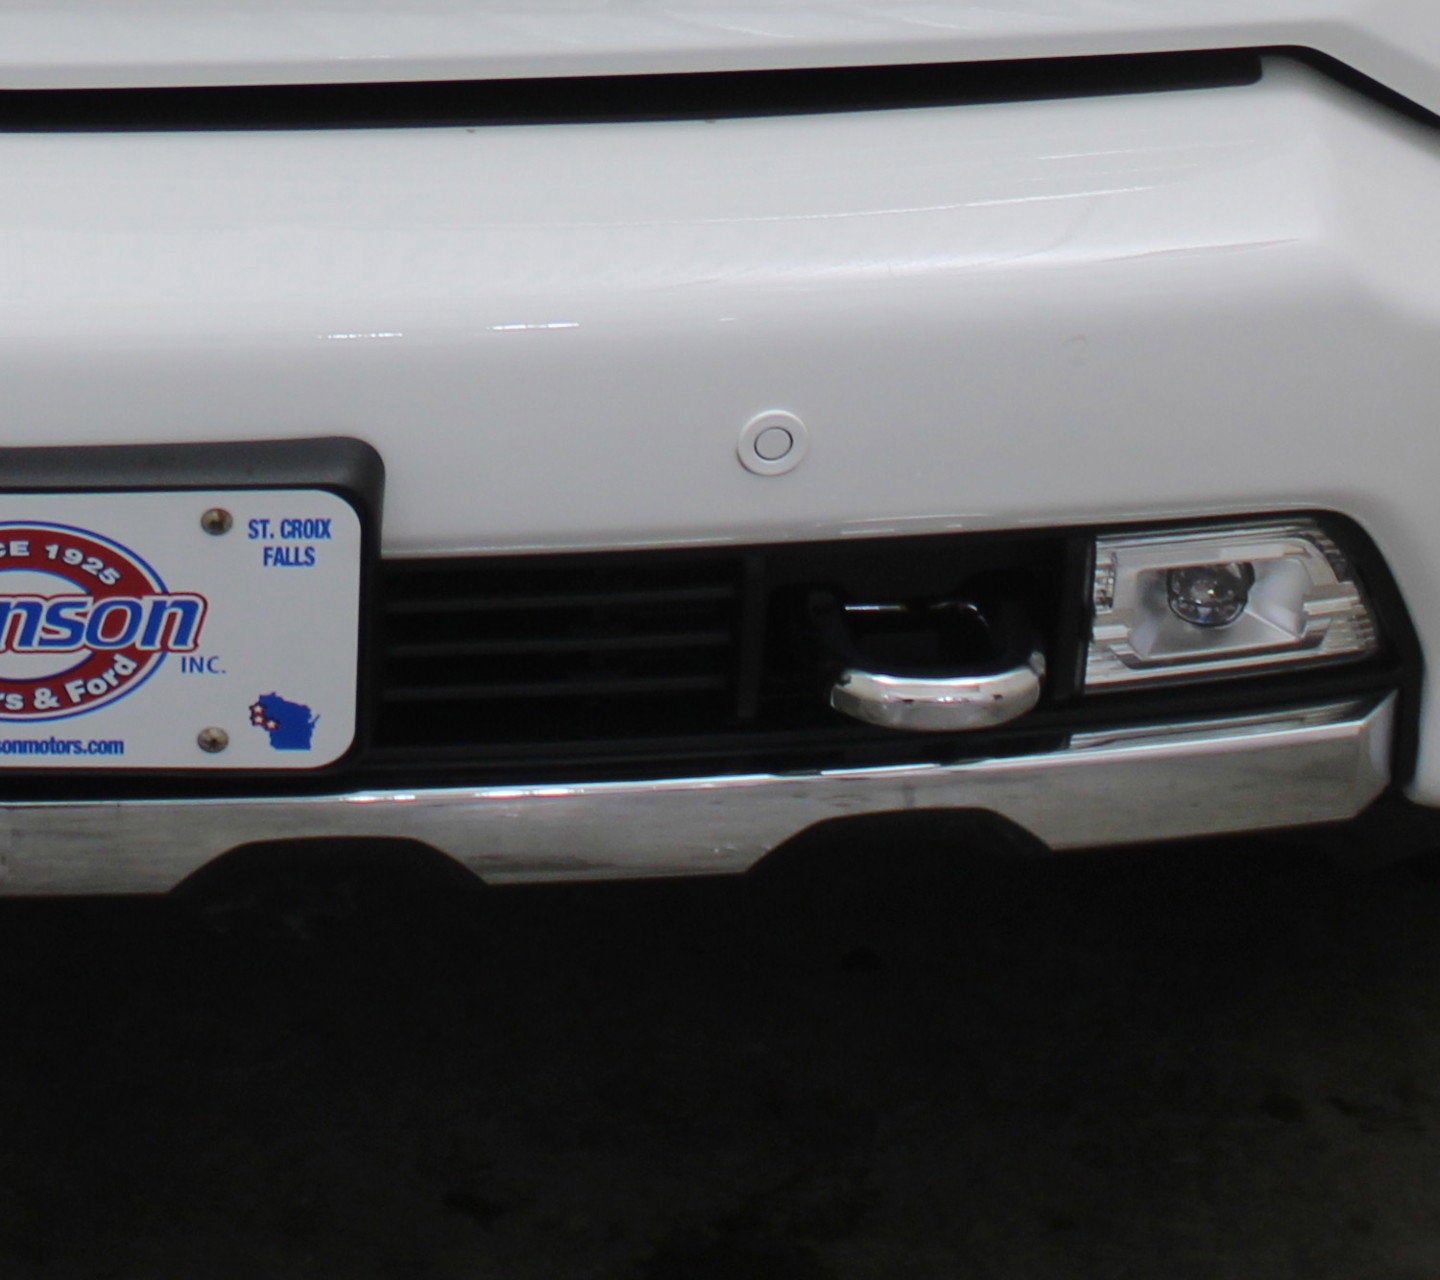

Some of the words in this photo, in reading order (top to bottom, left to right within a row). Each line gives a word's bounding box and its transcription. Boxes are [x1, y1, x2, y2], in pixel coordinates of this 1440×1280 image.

[247, 518, 275, 541] ST.
[280, 518, 332, 541] CROIX
[44, 543, 121, 586] 1925
[262, 546, 316, 568] FALLS
[180, 655, 227, 675] INC.
[33, 686, 60, 711] &
[66, 653, 138, 705] Ford
